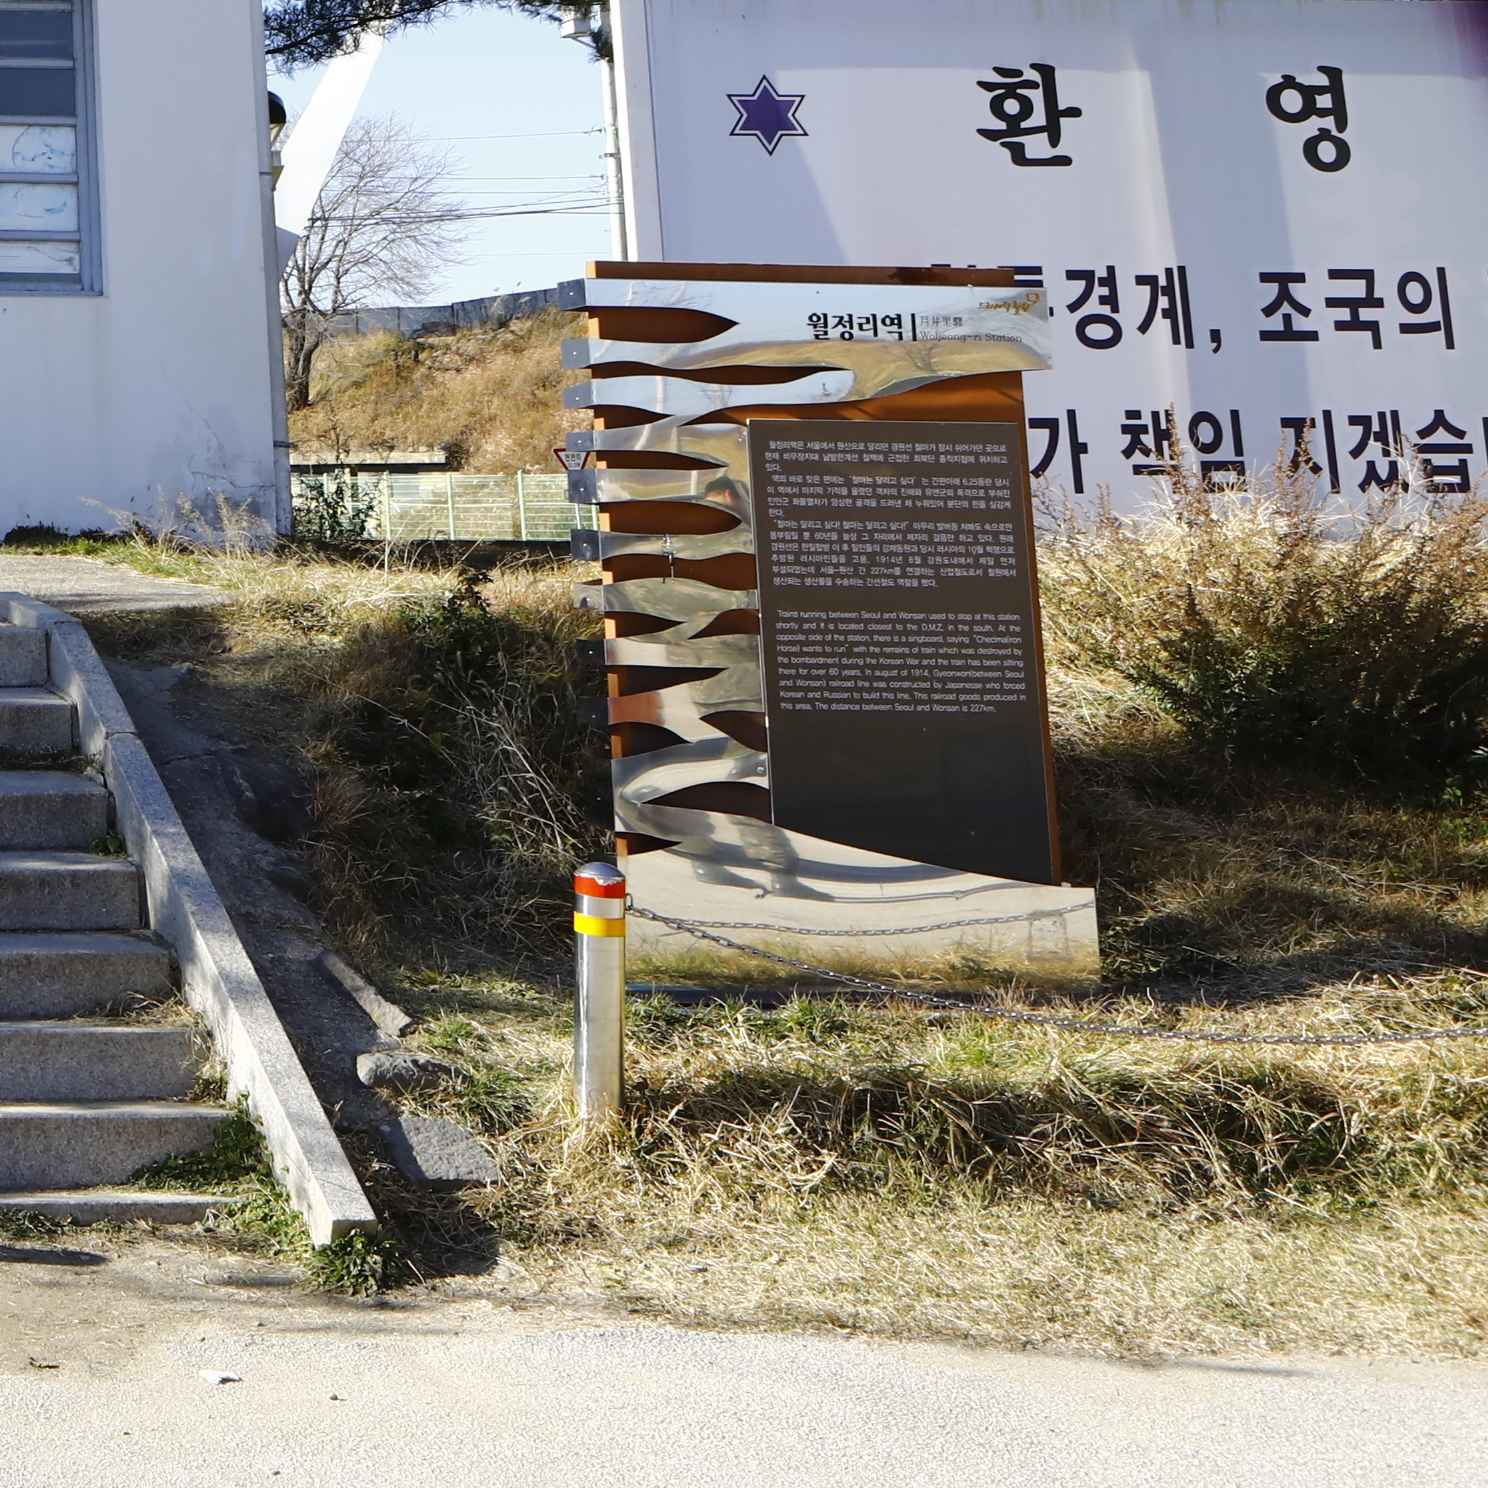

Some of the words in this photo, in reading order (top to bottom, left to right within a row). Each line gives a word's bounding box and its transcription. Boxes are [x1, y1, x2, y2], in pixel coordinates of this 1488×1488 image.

[807, 312, 904, 342] 월정리역
[1259, 266, 1455, 350] 조국의
[1280, 409, 1488, 494] 지겠습
